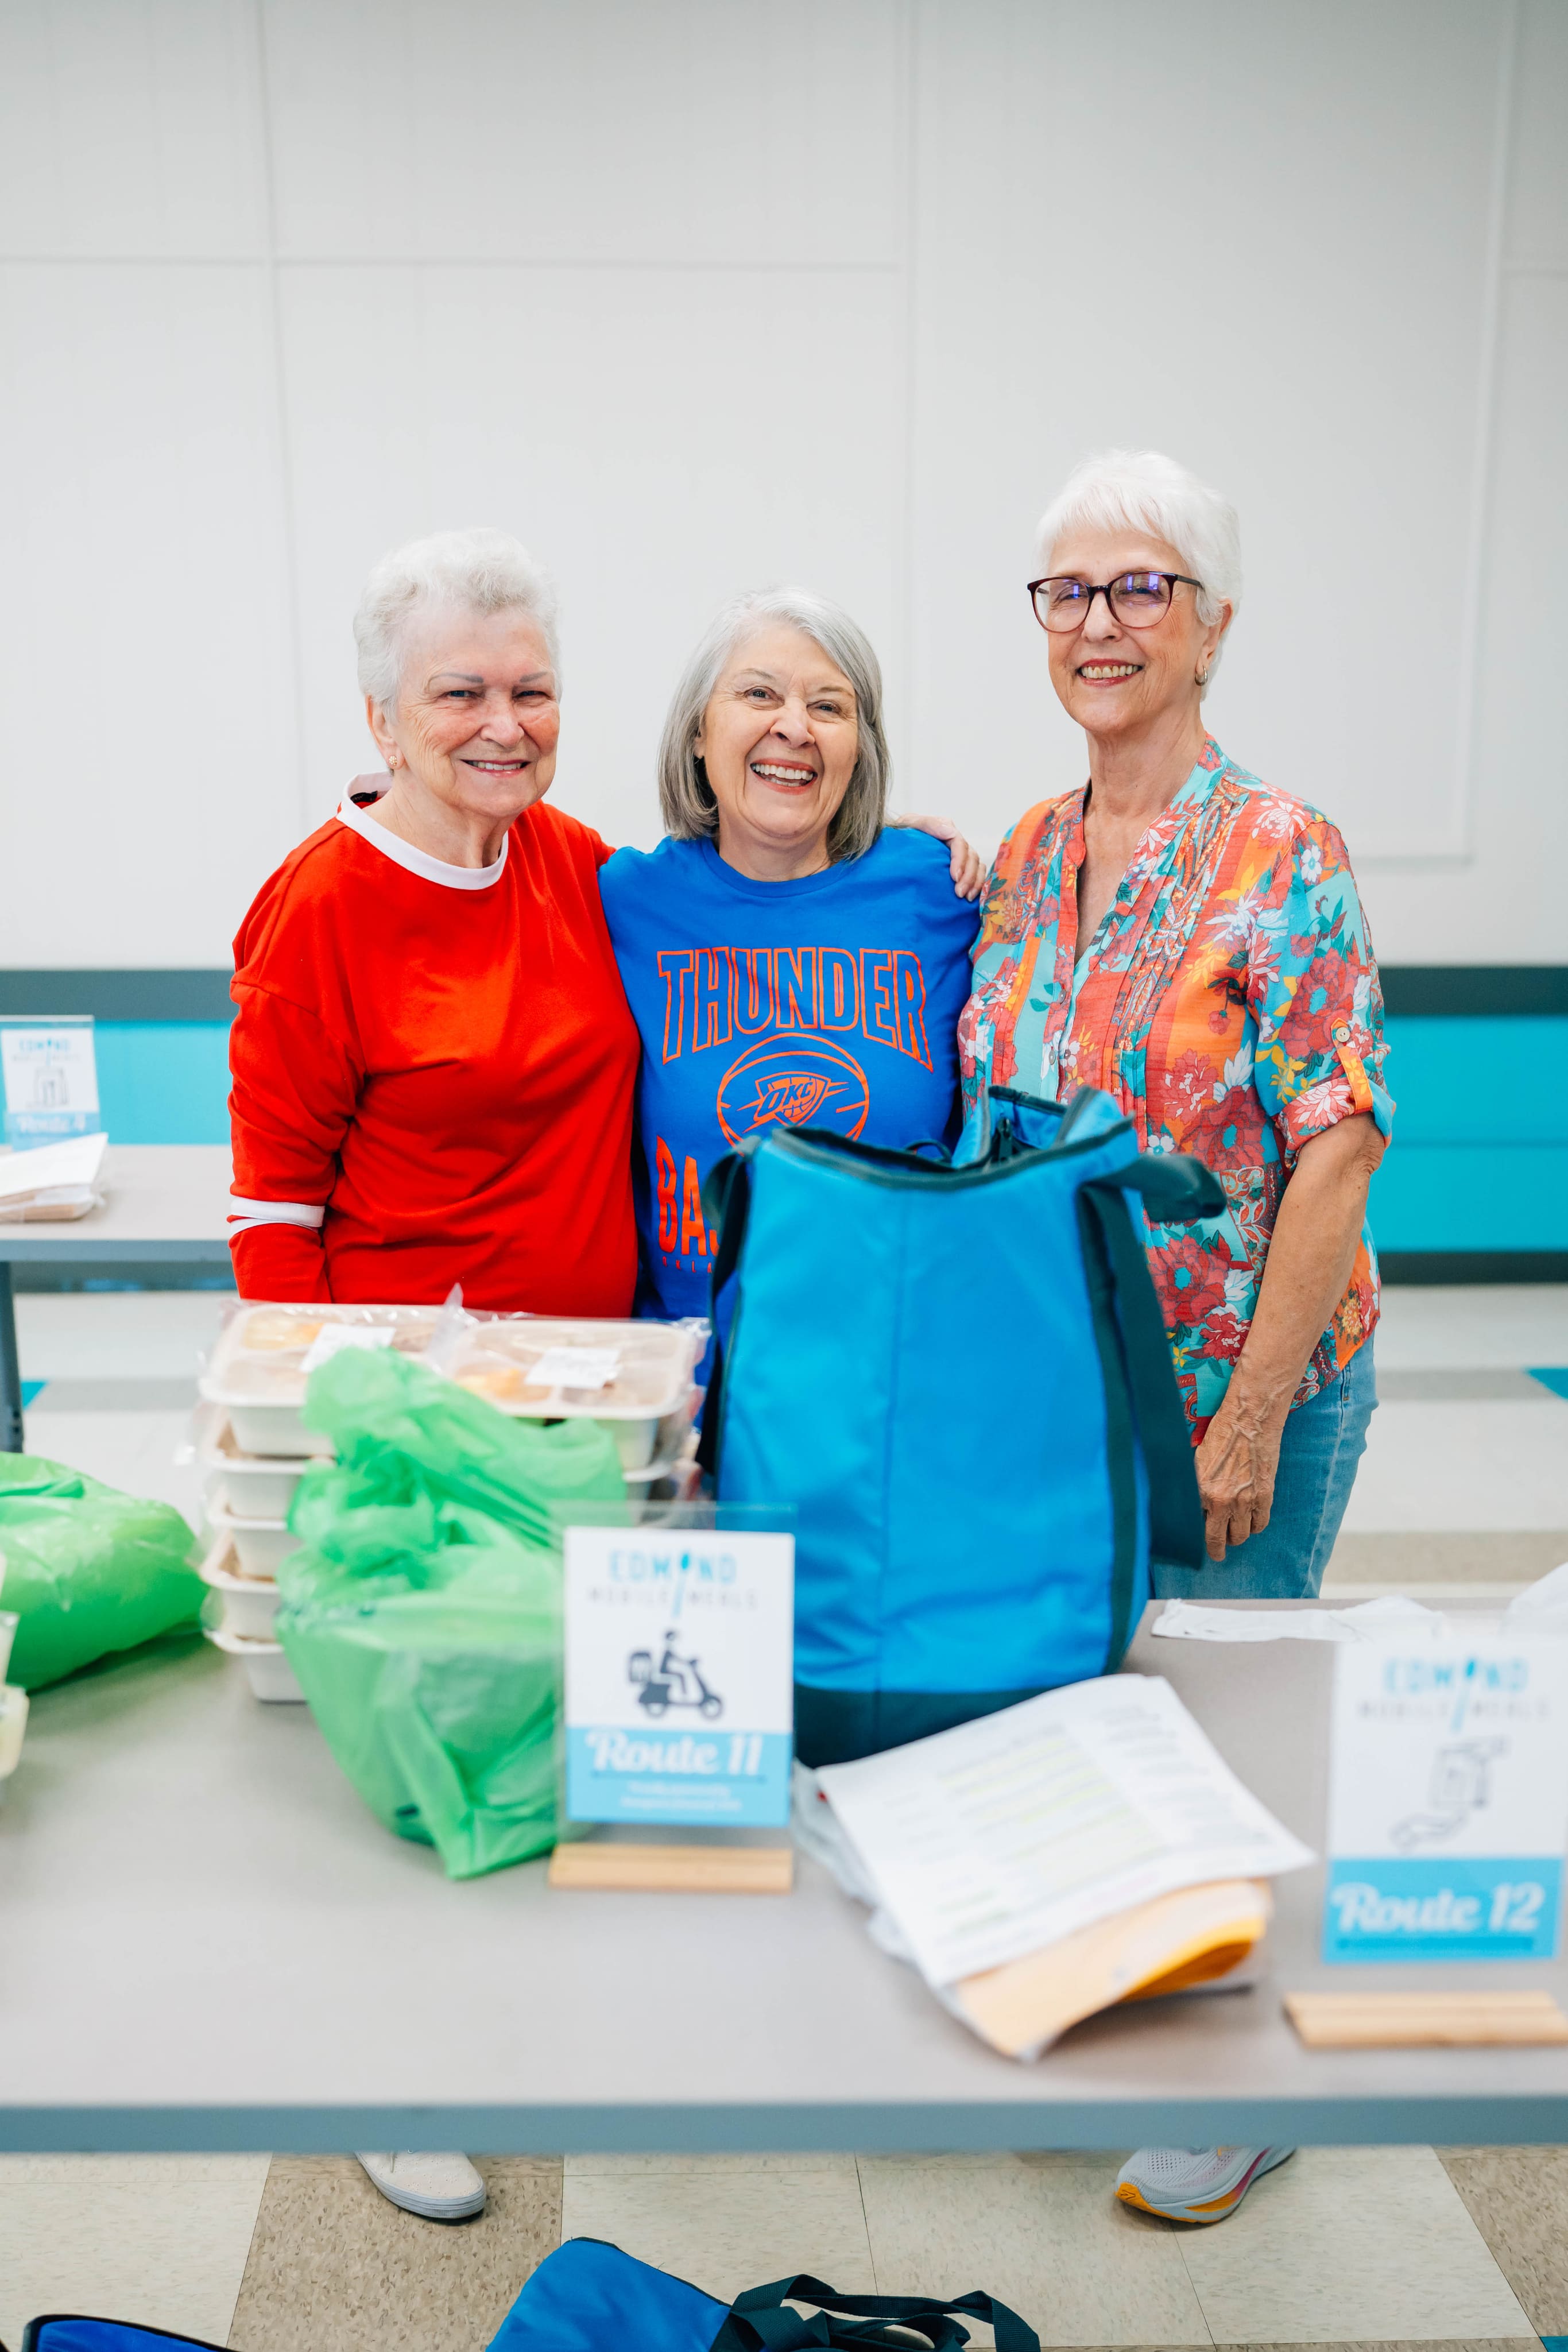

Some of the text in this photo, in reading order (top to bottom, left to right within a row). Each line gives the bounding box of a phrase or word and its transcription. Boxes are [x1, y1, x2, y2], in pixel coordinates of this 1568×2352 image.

[657, 946, 934, 1073] THUNDER
[757, 1081, 814, 1117] OKC
[656, 1135, 719, 1256] BA
[584, 1730, 764, 1775] Route 11
[1330, 1881, 1546, 1933] Route 12
